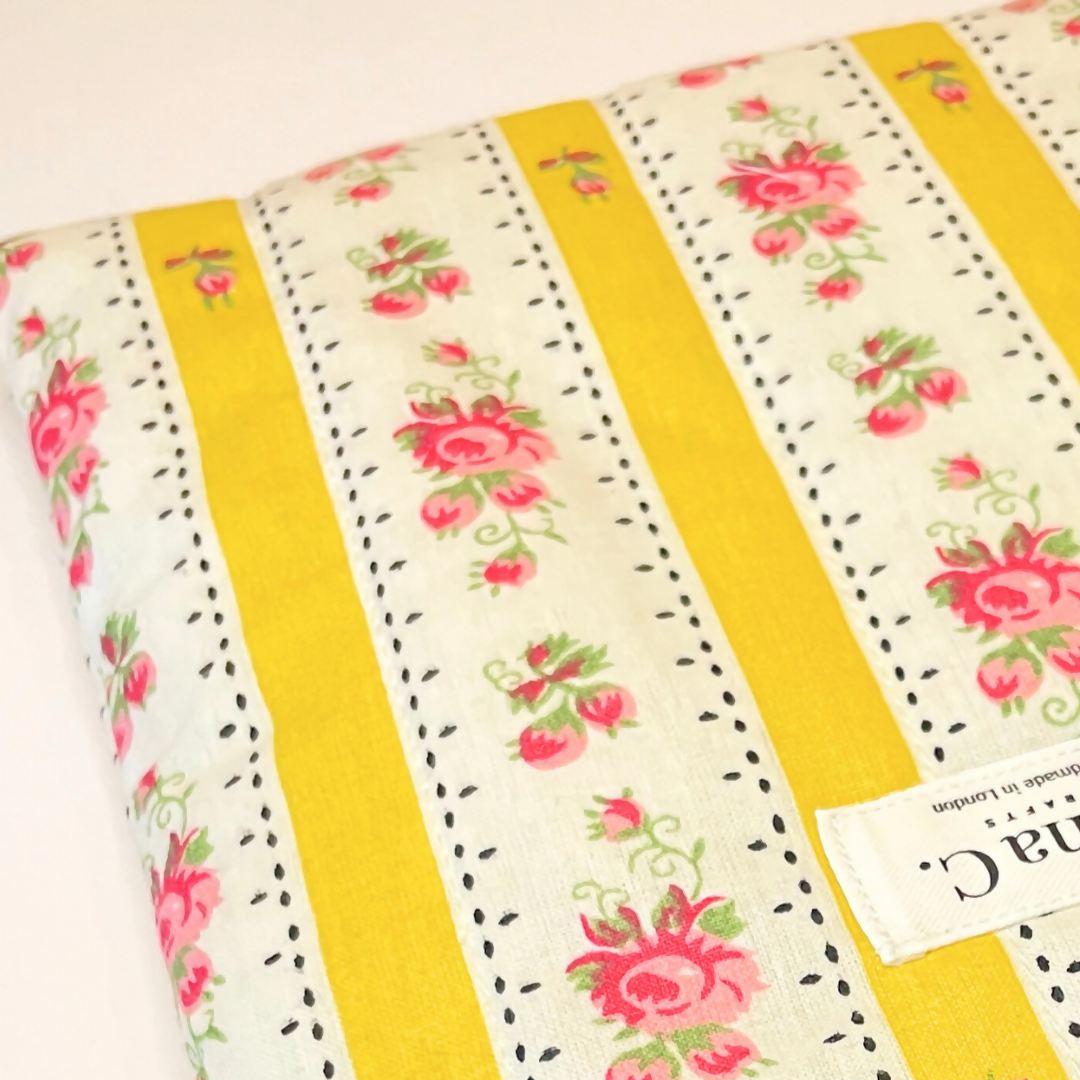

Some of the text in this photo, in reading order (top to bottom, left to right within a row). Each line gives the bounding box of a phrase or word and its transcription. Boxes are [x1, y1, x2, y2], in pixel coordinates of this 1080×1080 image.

[933, 788, 999, 814] London
[1003, 783, 1019, 795] in
[919, 850, 999, 902] C.
